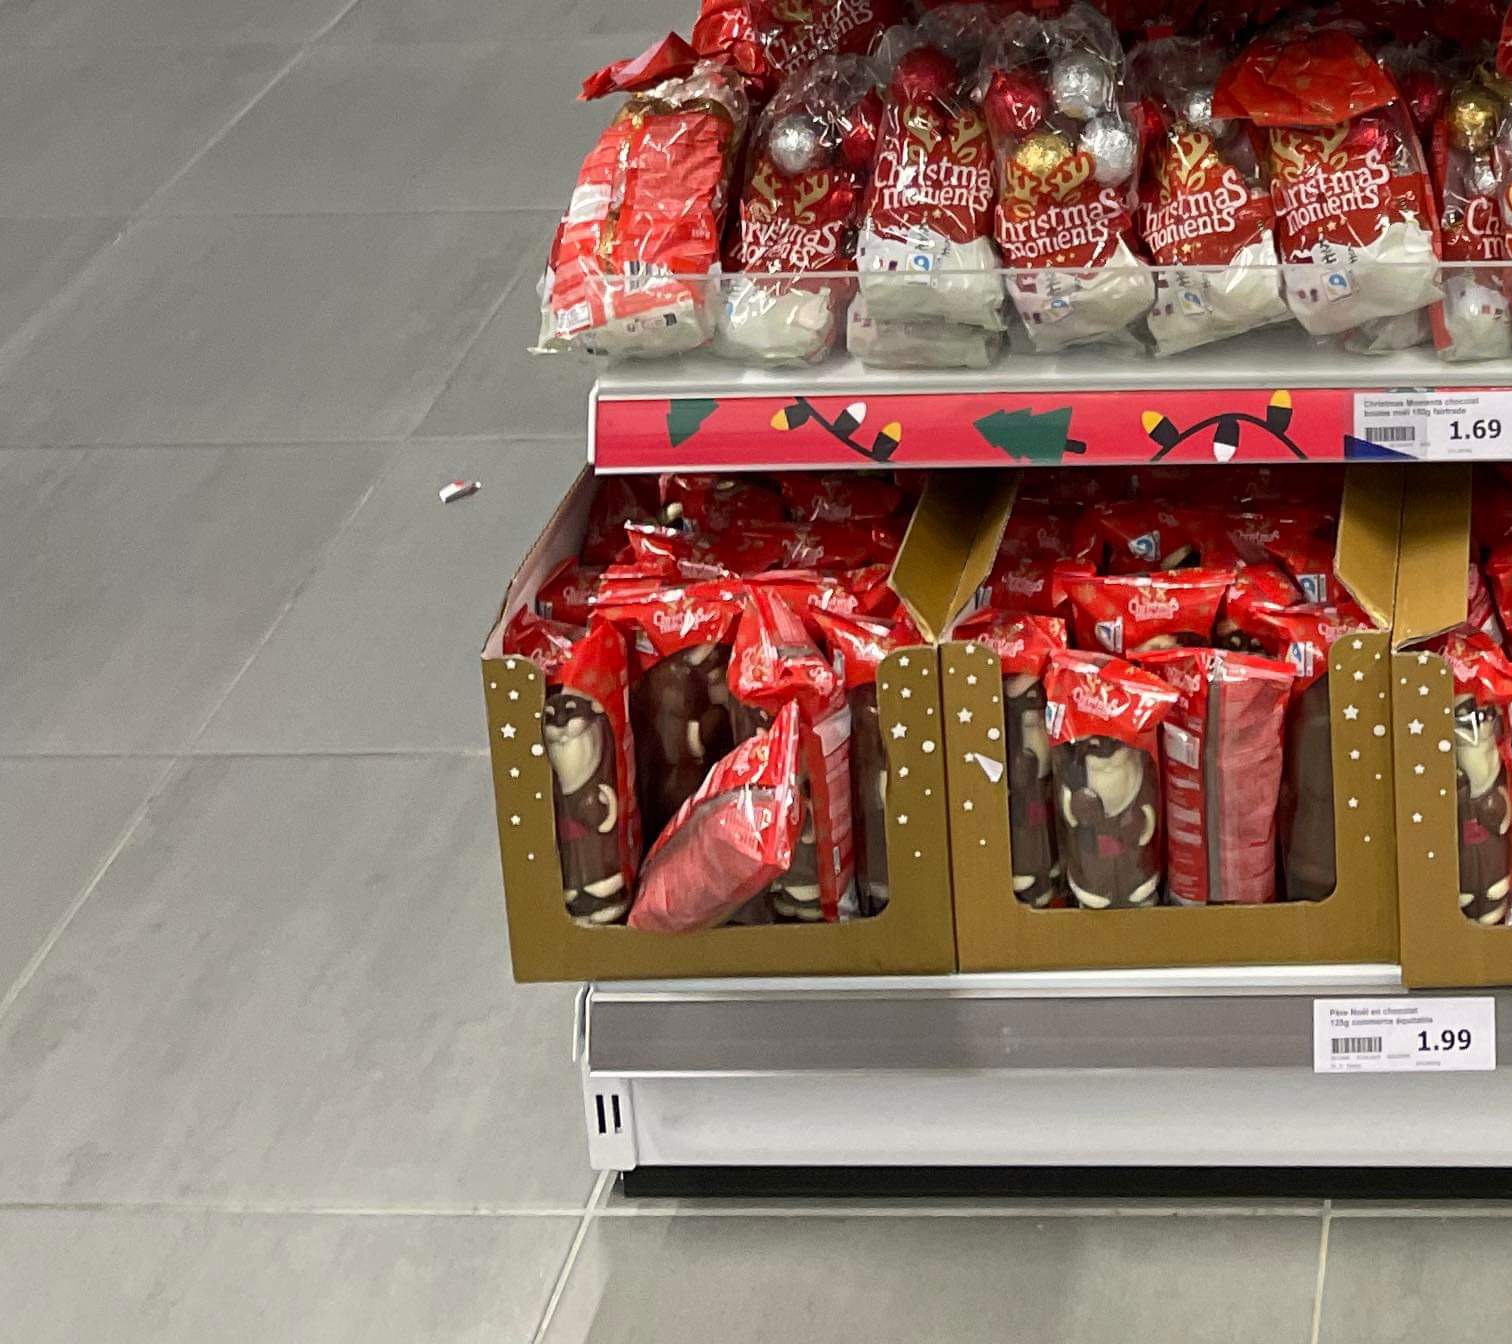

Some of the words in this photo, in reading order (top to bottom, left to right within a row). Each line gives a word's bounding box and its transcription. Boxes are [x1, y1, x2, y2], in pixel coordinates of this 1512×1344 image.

[873, 152, 993, 192] Christma
[1449, 418, 1502, 441] 1.69
[1417, 1028, 1472, 1052] 1.99
